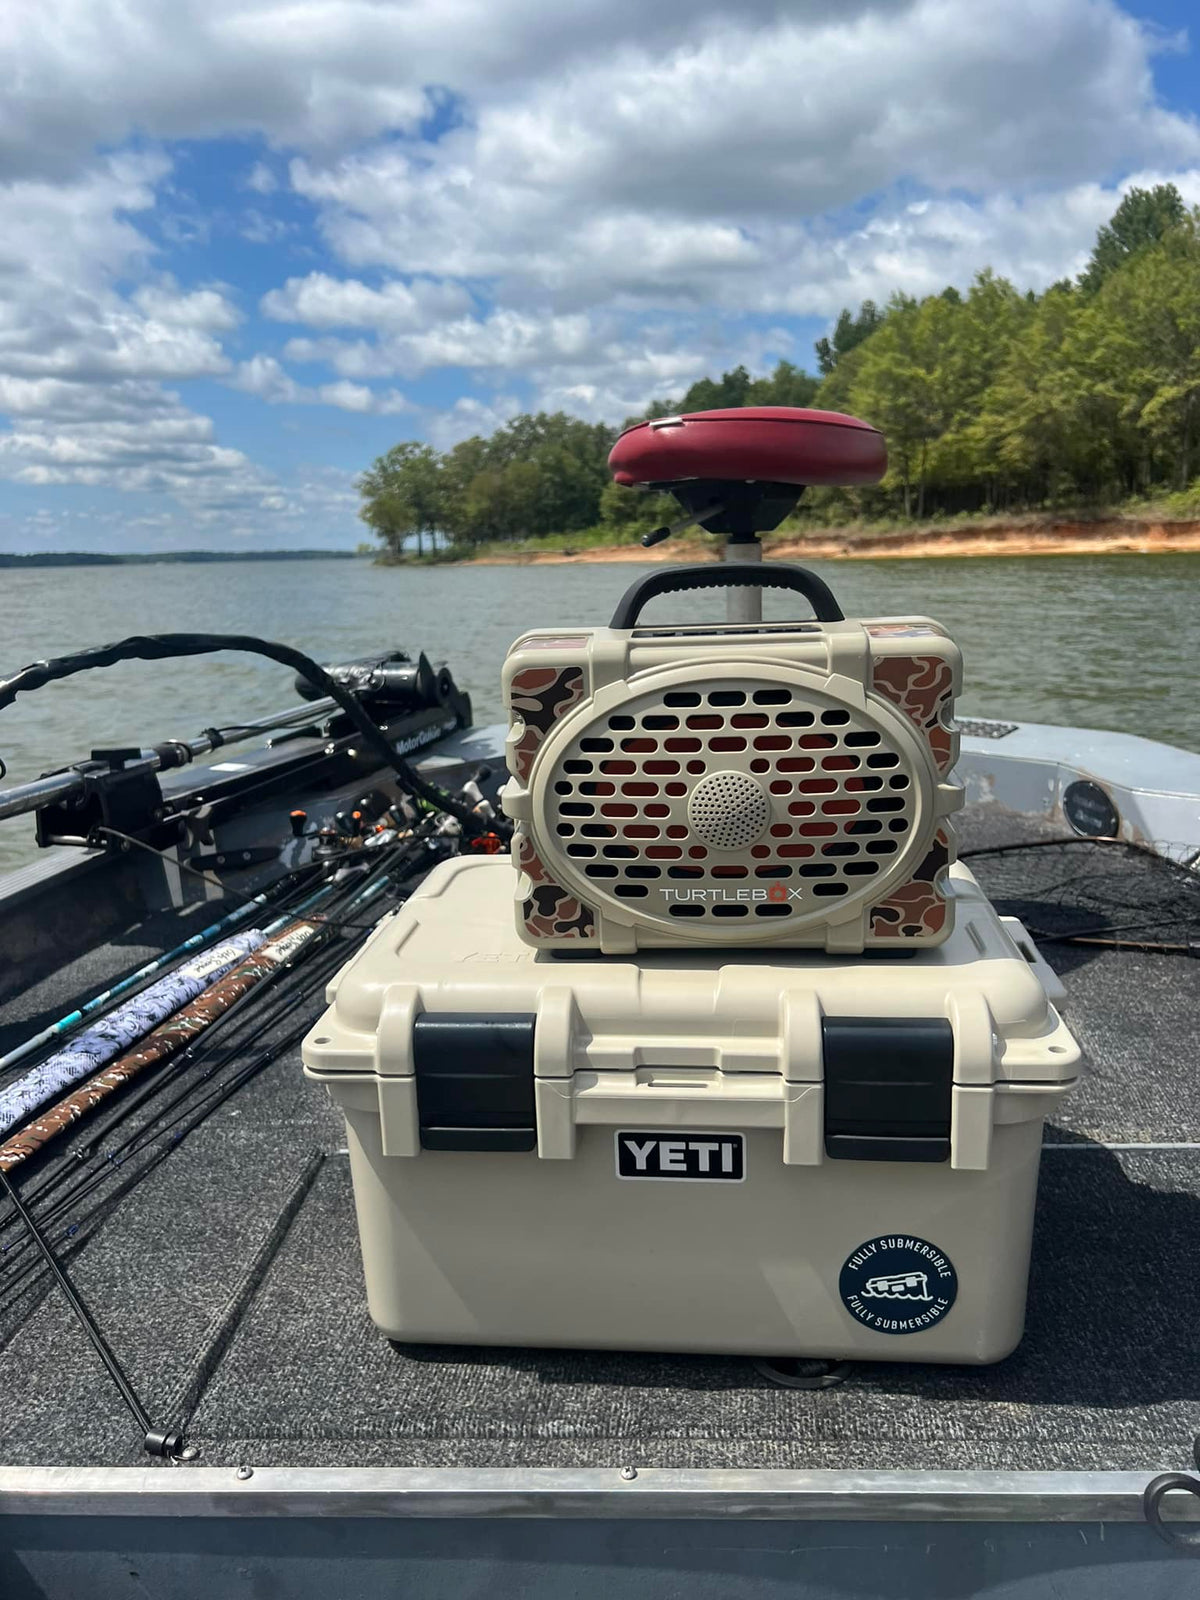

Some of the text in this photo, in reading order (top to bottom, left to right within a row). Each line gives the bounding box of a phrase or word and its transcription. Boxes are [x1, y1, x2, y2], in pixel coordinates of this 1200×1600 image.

[659, 881, 803, 902] TURTLEBOX
[623, 1140, 733, 1172] YETI
[848, 1238, 951, 1278] FULLY SUBMERSIBLE
[847, 1294, 948, 1330] FULLY SUBMERSIBLE
